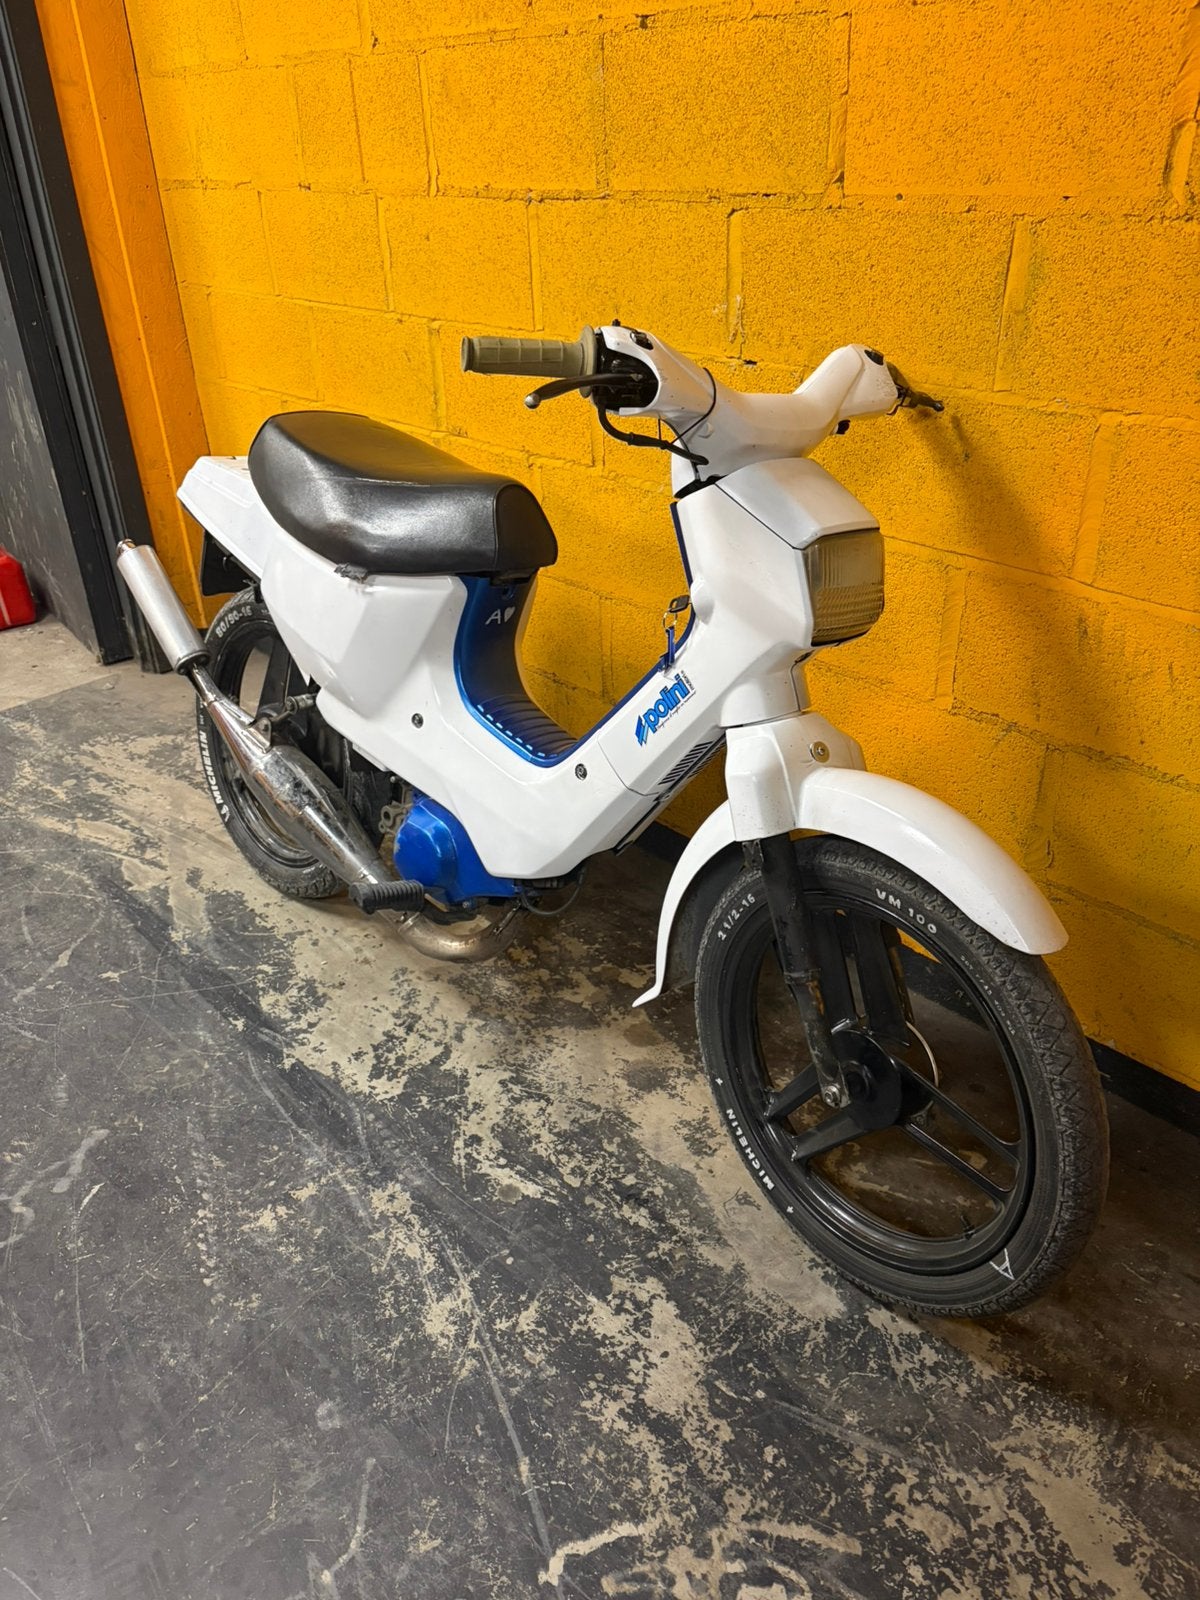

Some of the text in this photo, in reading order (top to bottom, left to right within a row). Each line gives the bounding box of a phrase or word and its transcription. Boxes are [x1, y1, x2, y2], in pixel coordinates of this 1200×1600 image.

[485, 609, 501, 624] A
[643, 673, 690, 734] polini
[200, 730, 223, 804] MICHELIN
[875, 888, 937, 934] VM 100
[726, 1108, 775, 1190] MICHELIN
